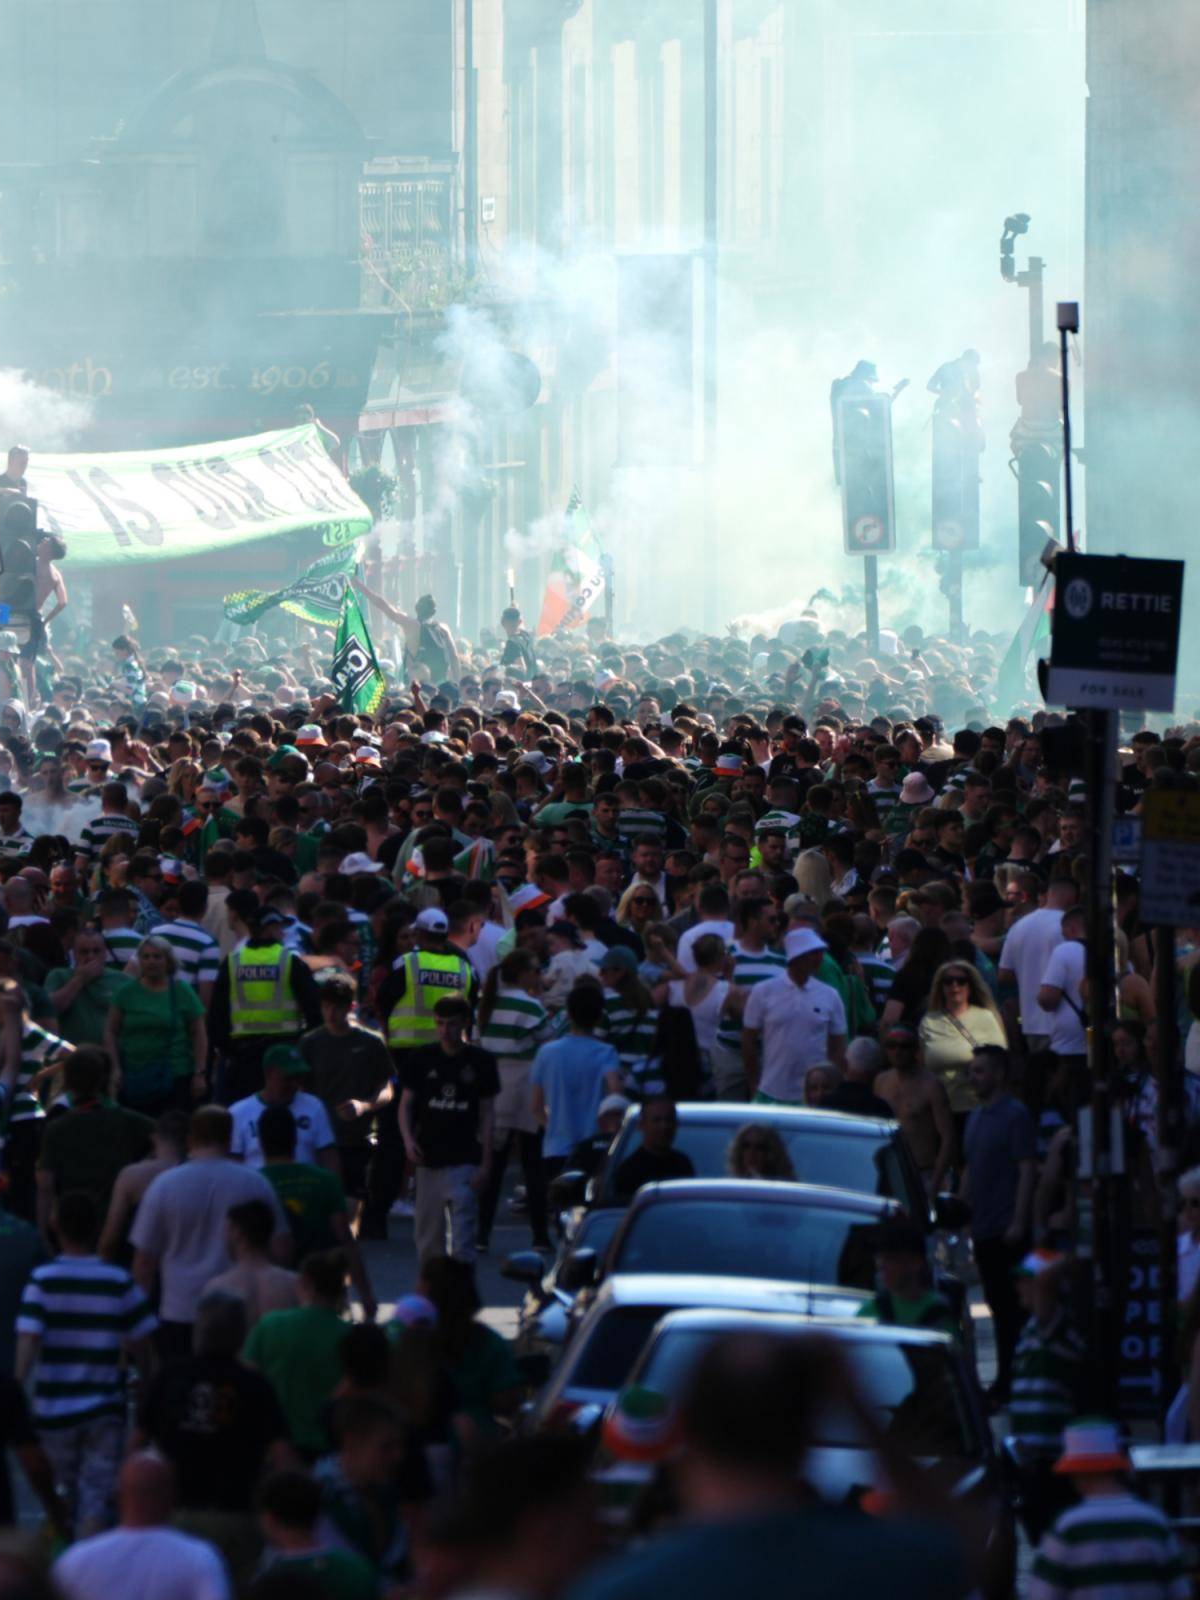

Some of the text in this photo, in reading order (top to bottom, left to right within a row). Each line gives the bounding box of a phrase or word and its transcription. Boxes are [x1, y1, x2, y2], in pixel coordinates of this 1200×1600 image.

[249, 361, 330, 393] 1906
[1100, 592, 1173, 613] RETTIE
[1080, 683, 1144, 697] FOR SALE
[237, 966, 277, 979] POLICE
[420, 971, 460, 987] POLICE
